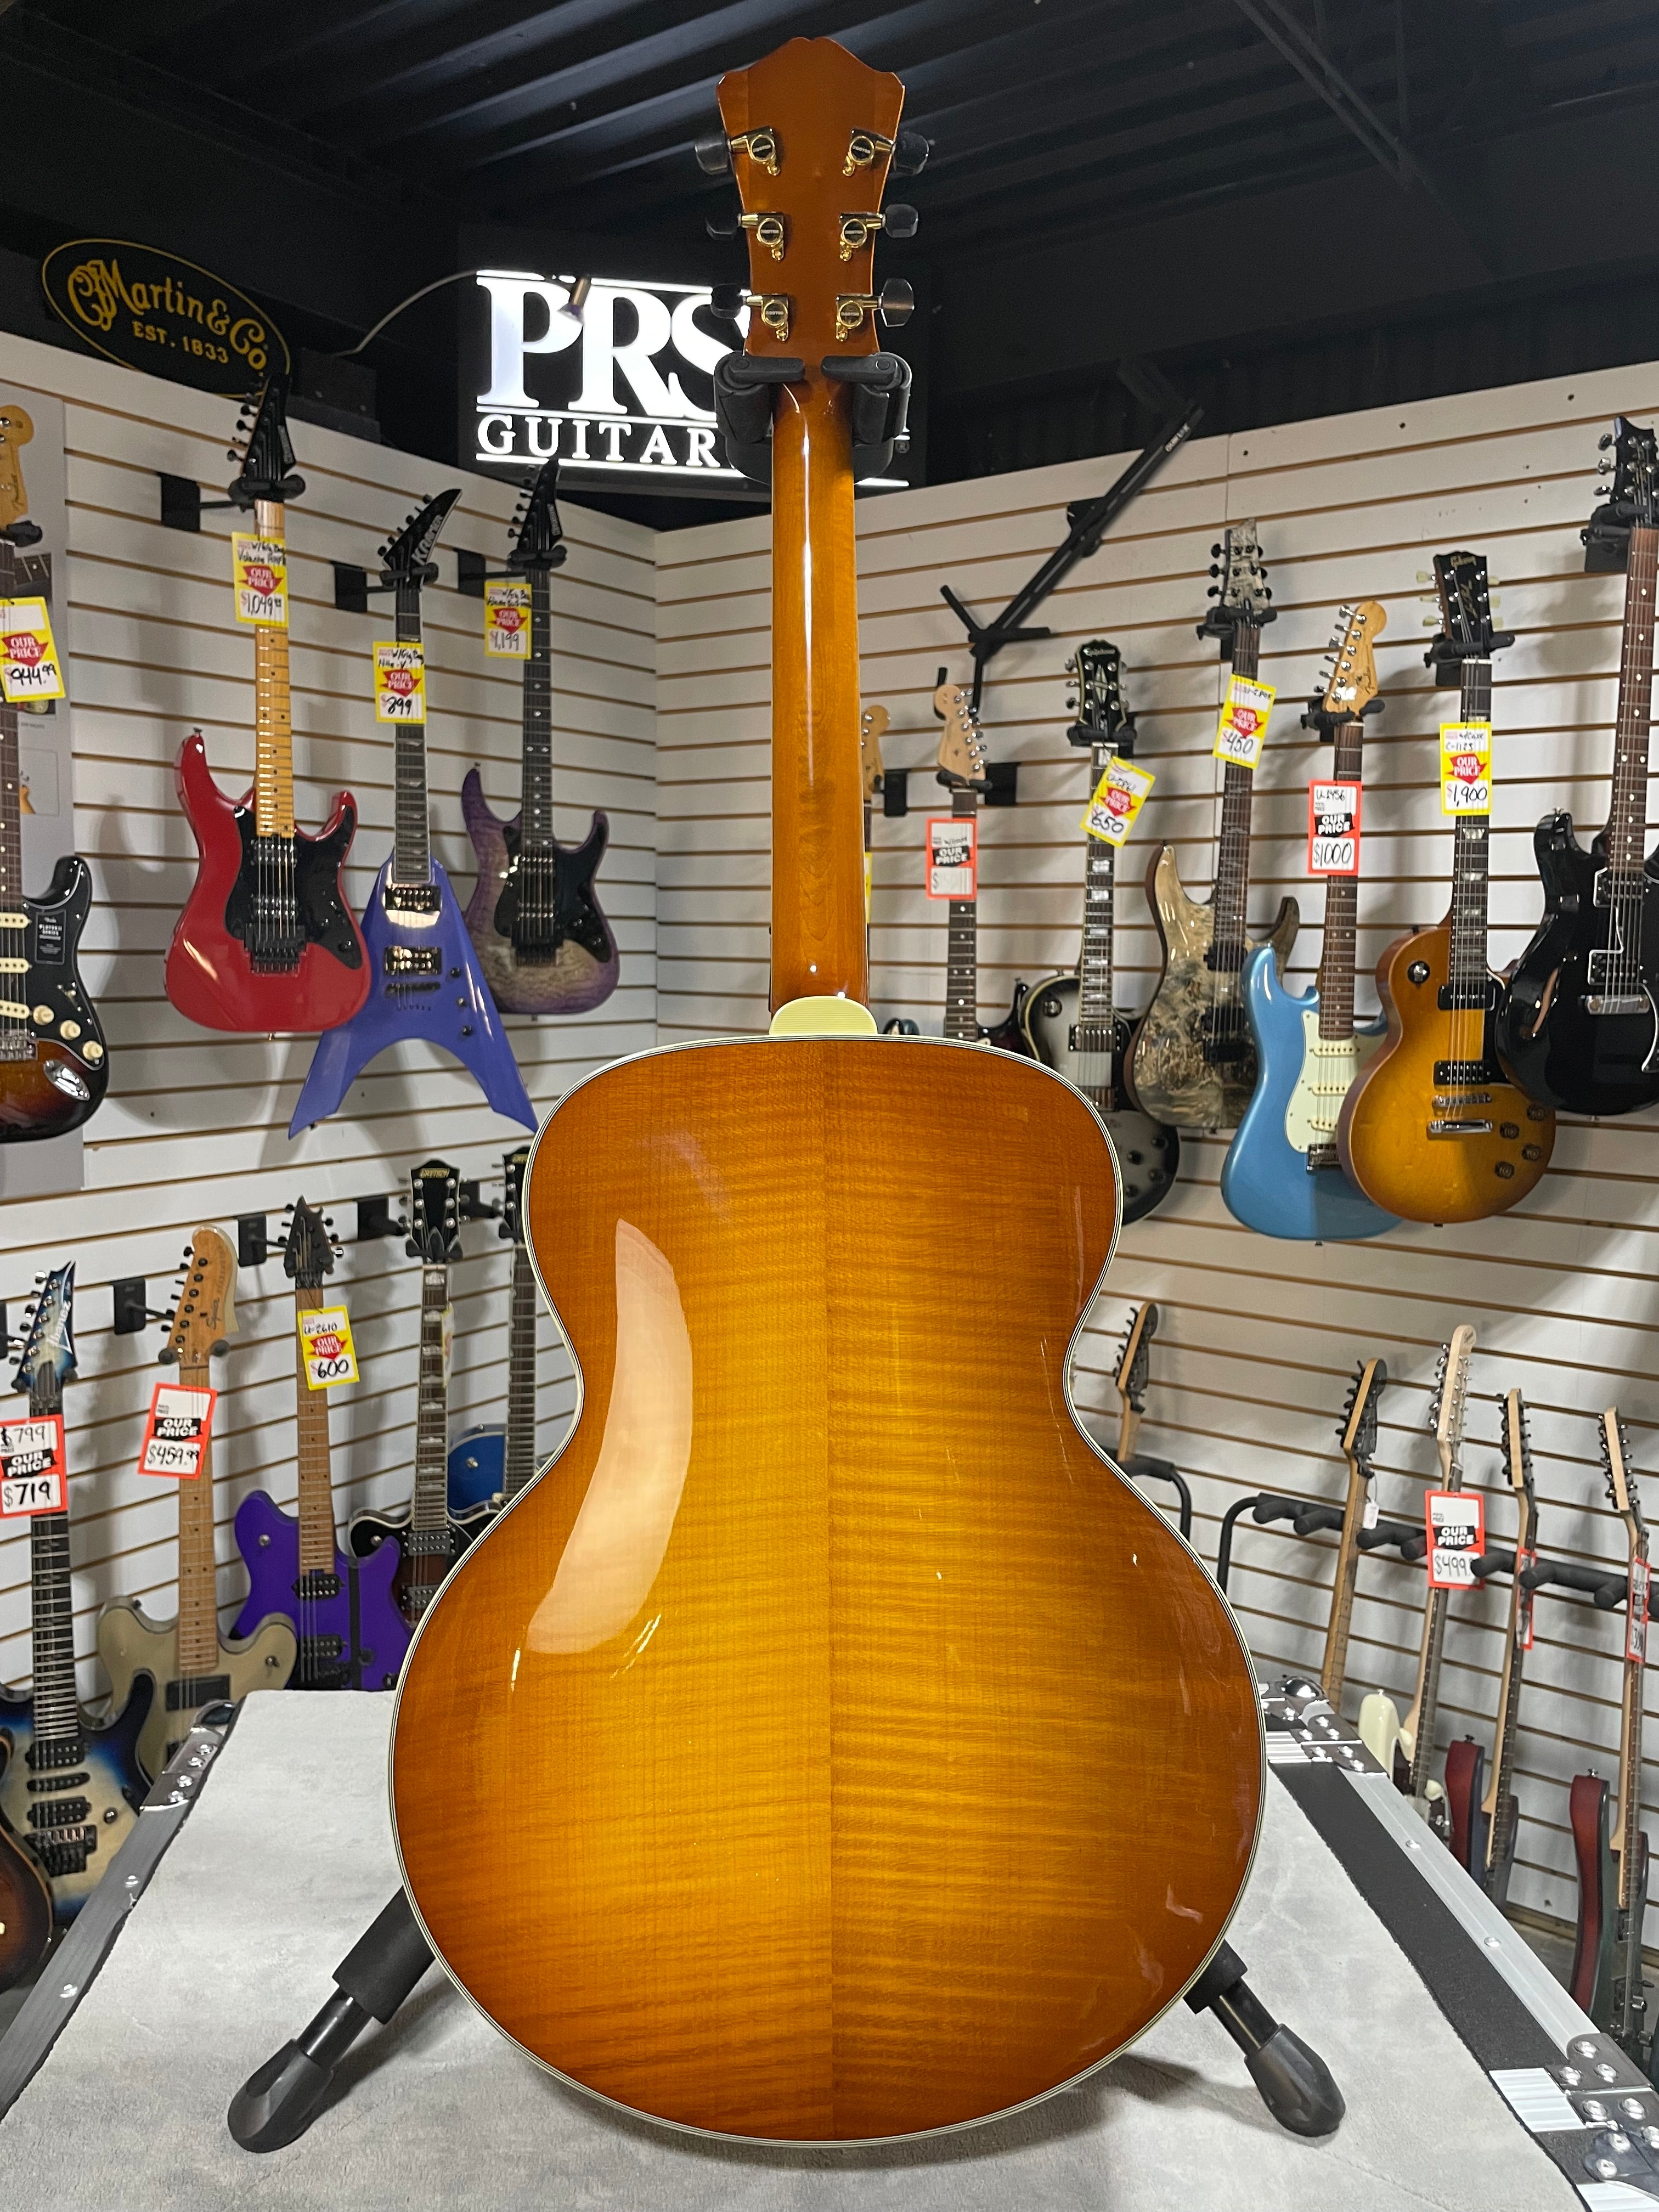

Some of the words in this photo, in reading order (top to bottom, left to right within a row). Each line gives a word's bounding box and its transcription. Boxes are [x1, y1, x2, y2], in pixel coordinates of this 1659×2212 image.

[206, 298, 230, 336] &
[132, 320, 176, 348] EST.
[182, 336, 229, 364] 1833
[477, 277, 750, 421] PRS
[477, 415, 721, 468] GUITAR
[251, 568, 273, 579] OUR
[247, 577, 274, 590] PRICE
[10, 636, 36, 648] OUR
[10, 647, 43, 659] PRICE
[1457, 757, 1477, 766] OUR
[1454, 765, 1481, 776] PRICE
[1321, 815, 1345, 824] OUR
[1318, 822, 1350, 835] PRICE
[939, 847, 963, 857] OUR
[1313, 842, 1352, 867] $1000
[935, 853, 968, 865] PRICE
[317, 1335, 337, 1346] OUR
[315, 1342, 342, 1356] PRICE
[163, 1418, 193, 1427] OUR
[156, 1426, 198, 1437] PRICE
[11, 1450, 44, 1466] OUR
[7, 1457, 52, 1477] PRICE
[3, 1481, 50, 1508] $719
[1441, 1526, 1468, 1537] OUR
[1437, 1534, 1474, 1546] PRICE
